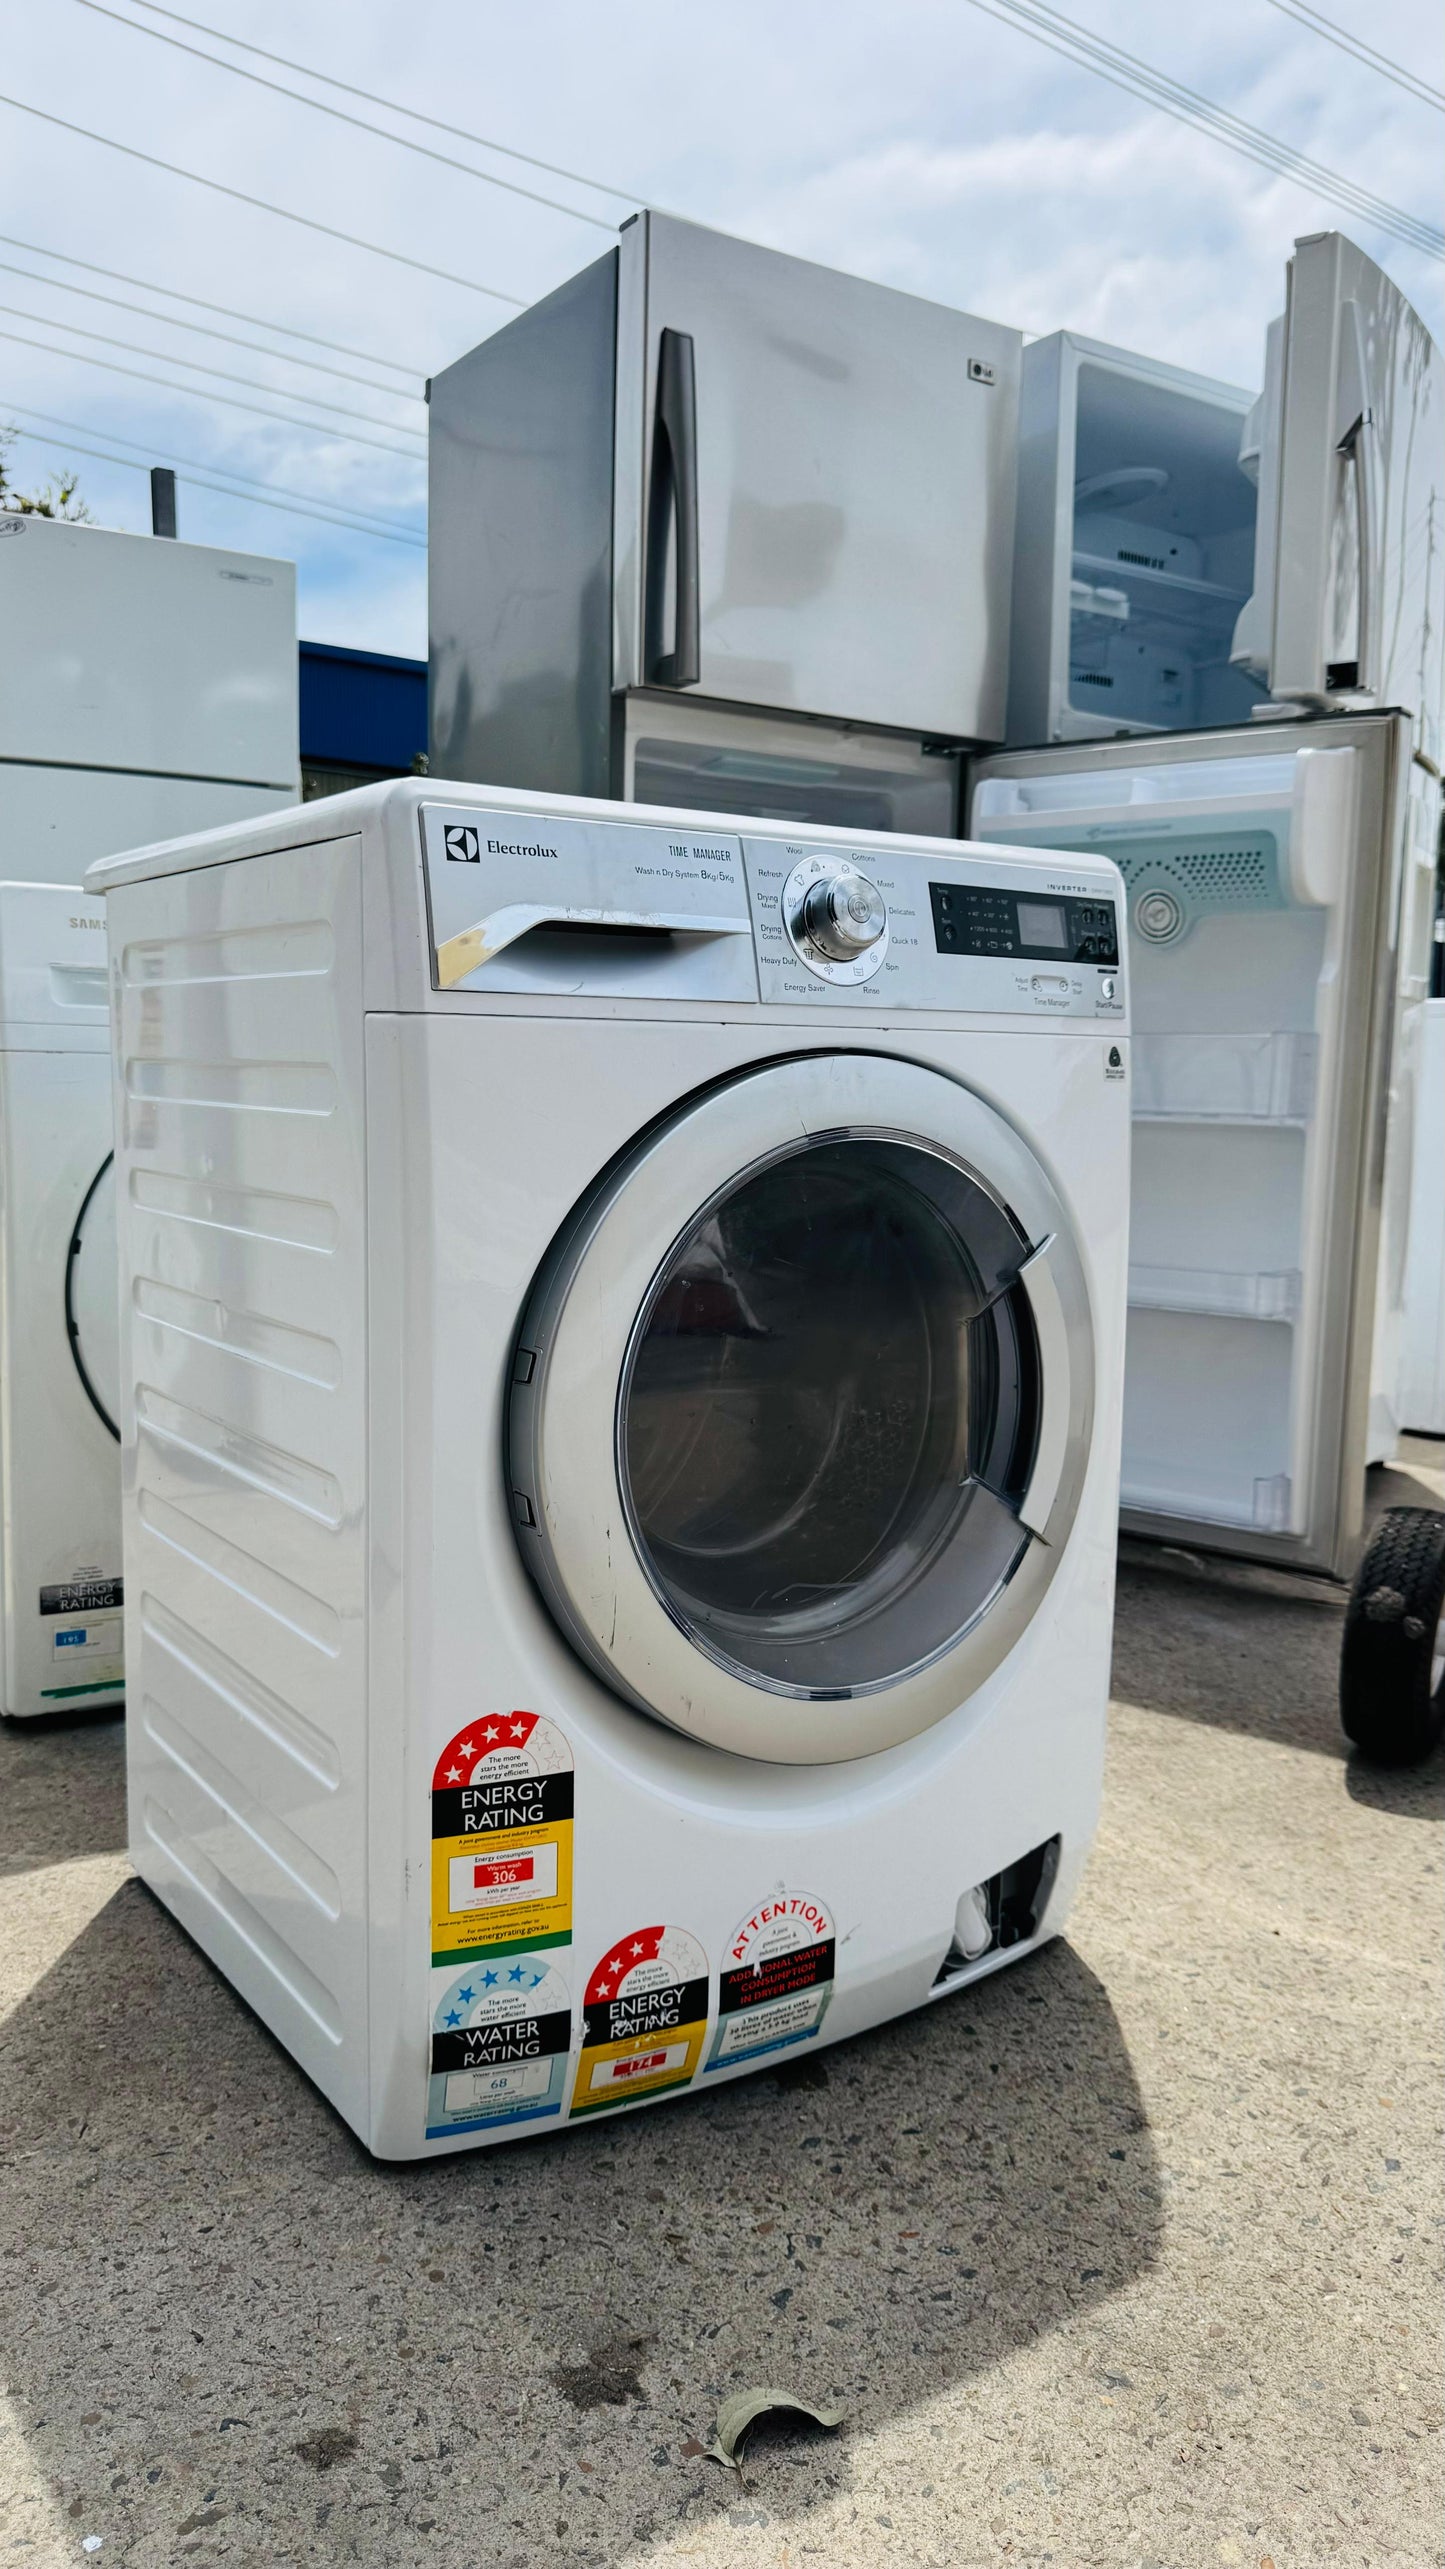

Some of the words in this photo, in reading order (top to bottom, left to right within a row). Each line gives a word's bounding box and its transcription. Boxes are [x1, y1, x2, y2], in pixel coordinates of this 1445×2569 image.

[487, 840, 558, 859] Electrolux
[668, 846, 688, 858] TIME
[692, 848, 732, 861] MANAGER
[786, 846, 802, 854] Wool
[852, 853, 876, 862] Cottons
[634, 866, 654, 875] Wash
[662, 868, 674, 878] Dry
[675, 870, 700, 880] System
[758, 868, 784, 878] Refresh
[876, 880, 895, 888] Mixed
[1047, 884, 1087, 892] INVERTER
[757, 893, 778, 903] Drying
[888, 906, 916, 916] Delicates
[70, 918, 108, 930] SAMS
[760, 924, 782, 934] Drying
[892, 937, 908, 945] Quick
[760, 956, 781, 966] Heavy
[782, 957, 798, 966] Duty
[886, 963, 900, 972] Spin
[784, 983, 806, 992] Energy
[808, 984, 826, 992] Saver
[863, 986, 880, 994] Rinse
[60, 1582, 116, 1598] ENERGY
[60, 1595, 114, 1610] RATING
[504, 1769, 530, 1777] efficient
[462, 1780, 548, 1808] ENERGY
[464, 1804, 544, 1832] RATING
[474, 1852, 494, 1864] Energy
[496, 1849, 534, 1861] consumption
[492, 1869, 516, 1884] 306
[457, 1924, 550, 1944] www.energyrating.gov.au
[732, 1900, 827, 1960] ATTENTION
[728, 1958, 792, 1984] ADDIIONAL
[794, 1946, 828, 1962] WATER
[741, 1962, 816, 1992] CONSUMPTION
[626, 1984, 646, 1992] energy
[648, 1978, 670, 1988] efficient
[740, 1995, 752, 2004] IN
[754, 1984, 786, 2000] DRYER
[788, 1973, 816, 1990] MODE
[610, 1986, 686, 2020] ENERGY
[502, 2010, 526, 2018] efficient
[610, 2009, 680, 2039] RATING
[466, 2020, 540, 2046] WATER
[464, 2040, 540, 2066] RATING
[490, 2078, 508, 2090] 68
